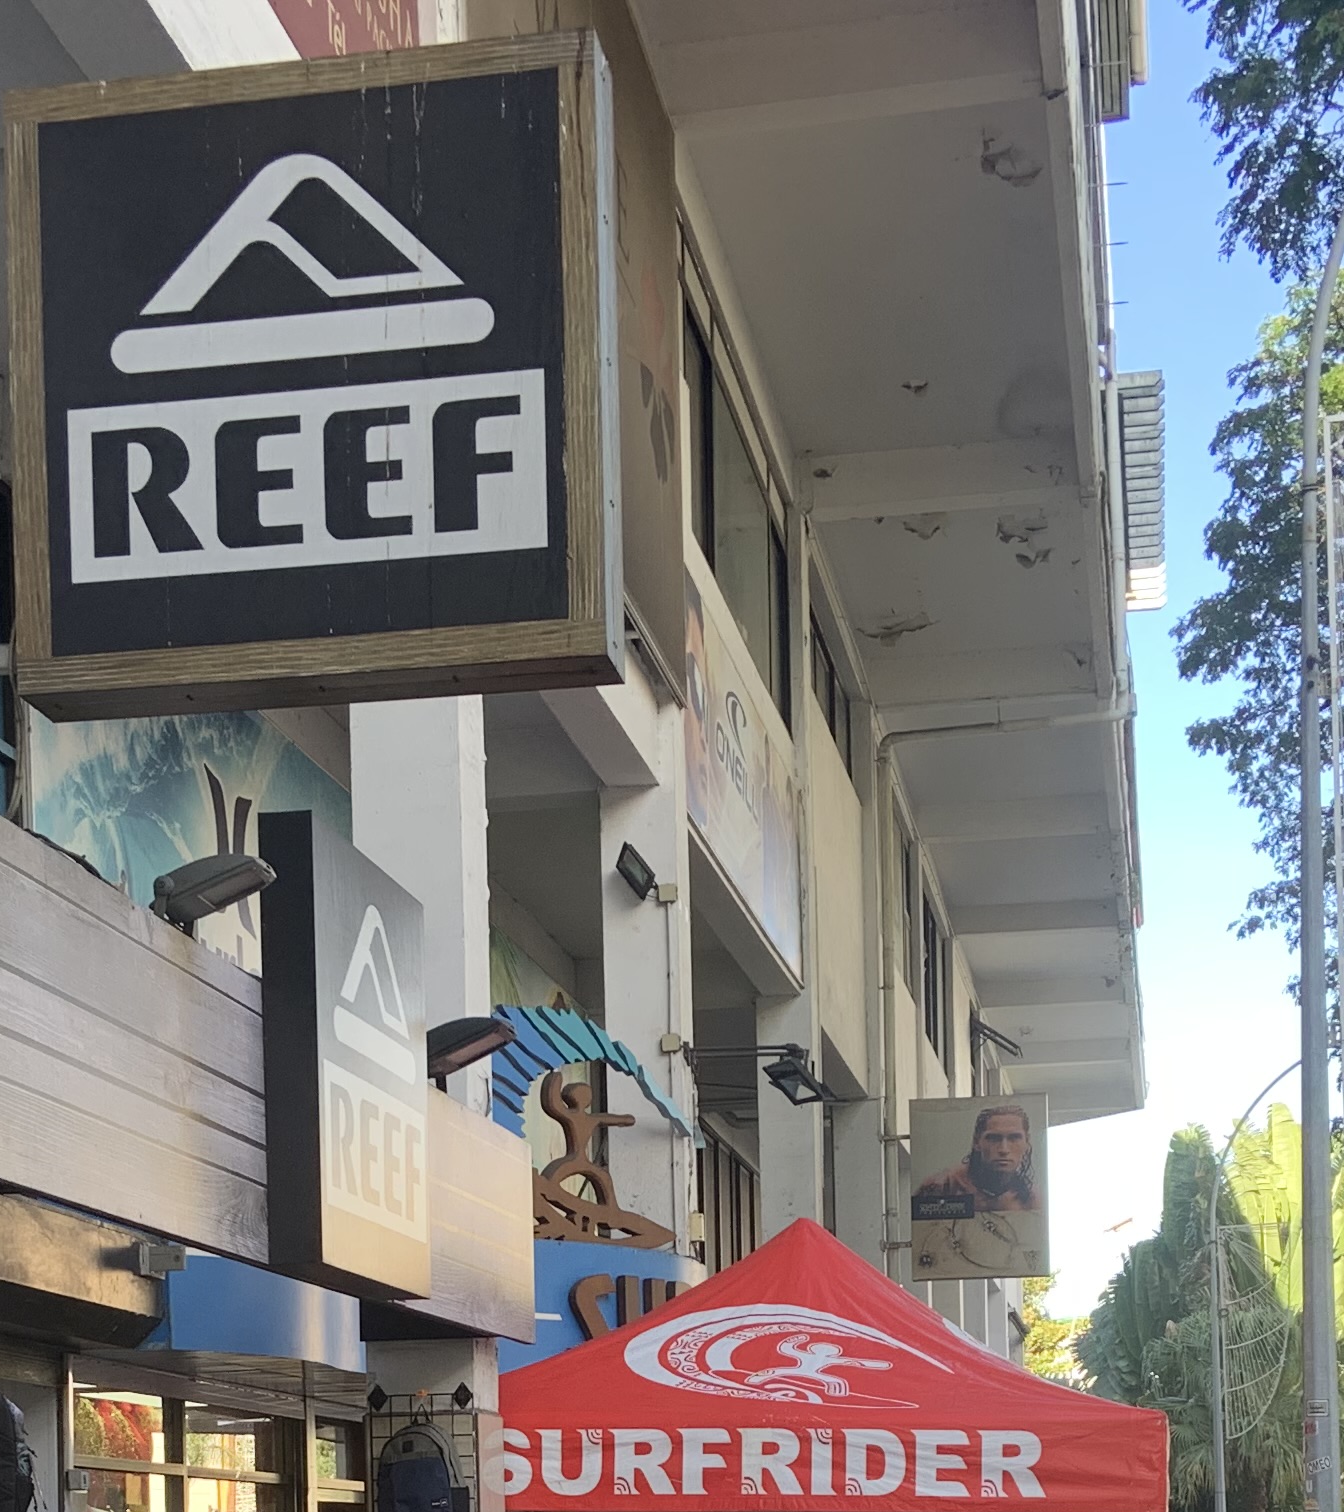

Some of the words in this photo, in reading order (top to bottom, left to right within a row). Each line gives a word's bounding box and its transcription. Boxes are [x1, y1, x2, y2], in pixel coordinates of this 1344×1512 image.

[91, 394, 521, 559] REEF
[329, 1080, 422, 1223] REEF
[482, 1428, 1048, 1498] SURFRIDER
